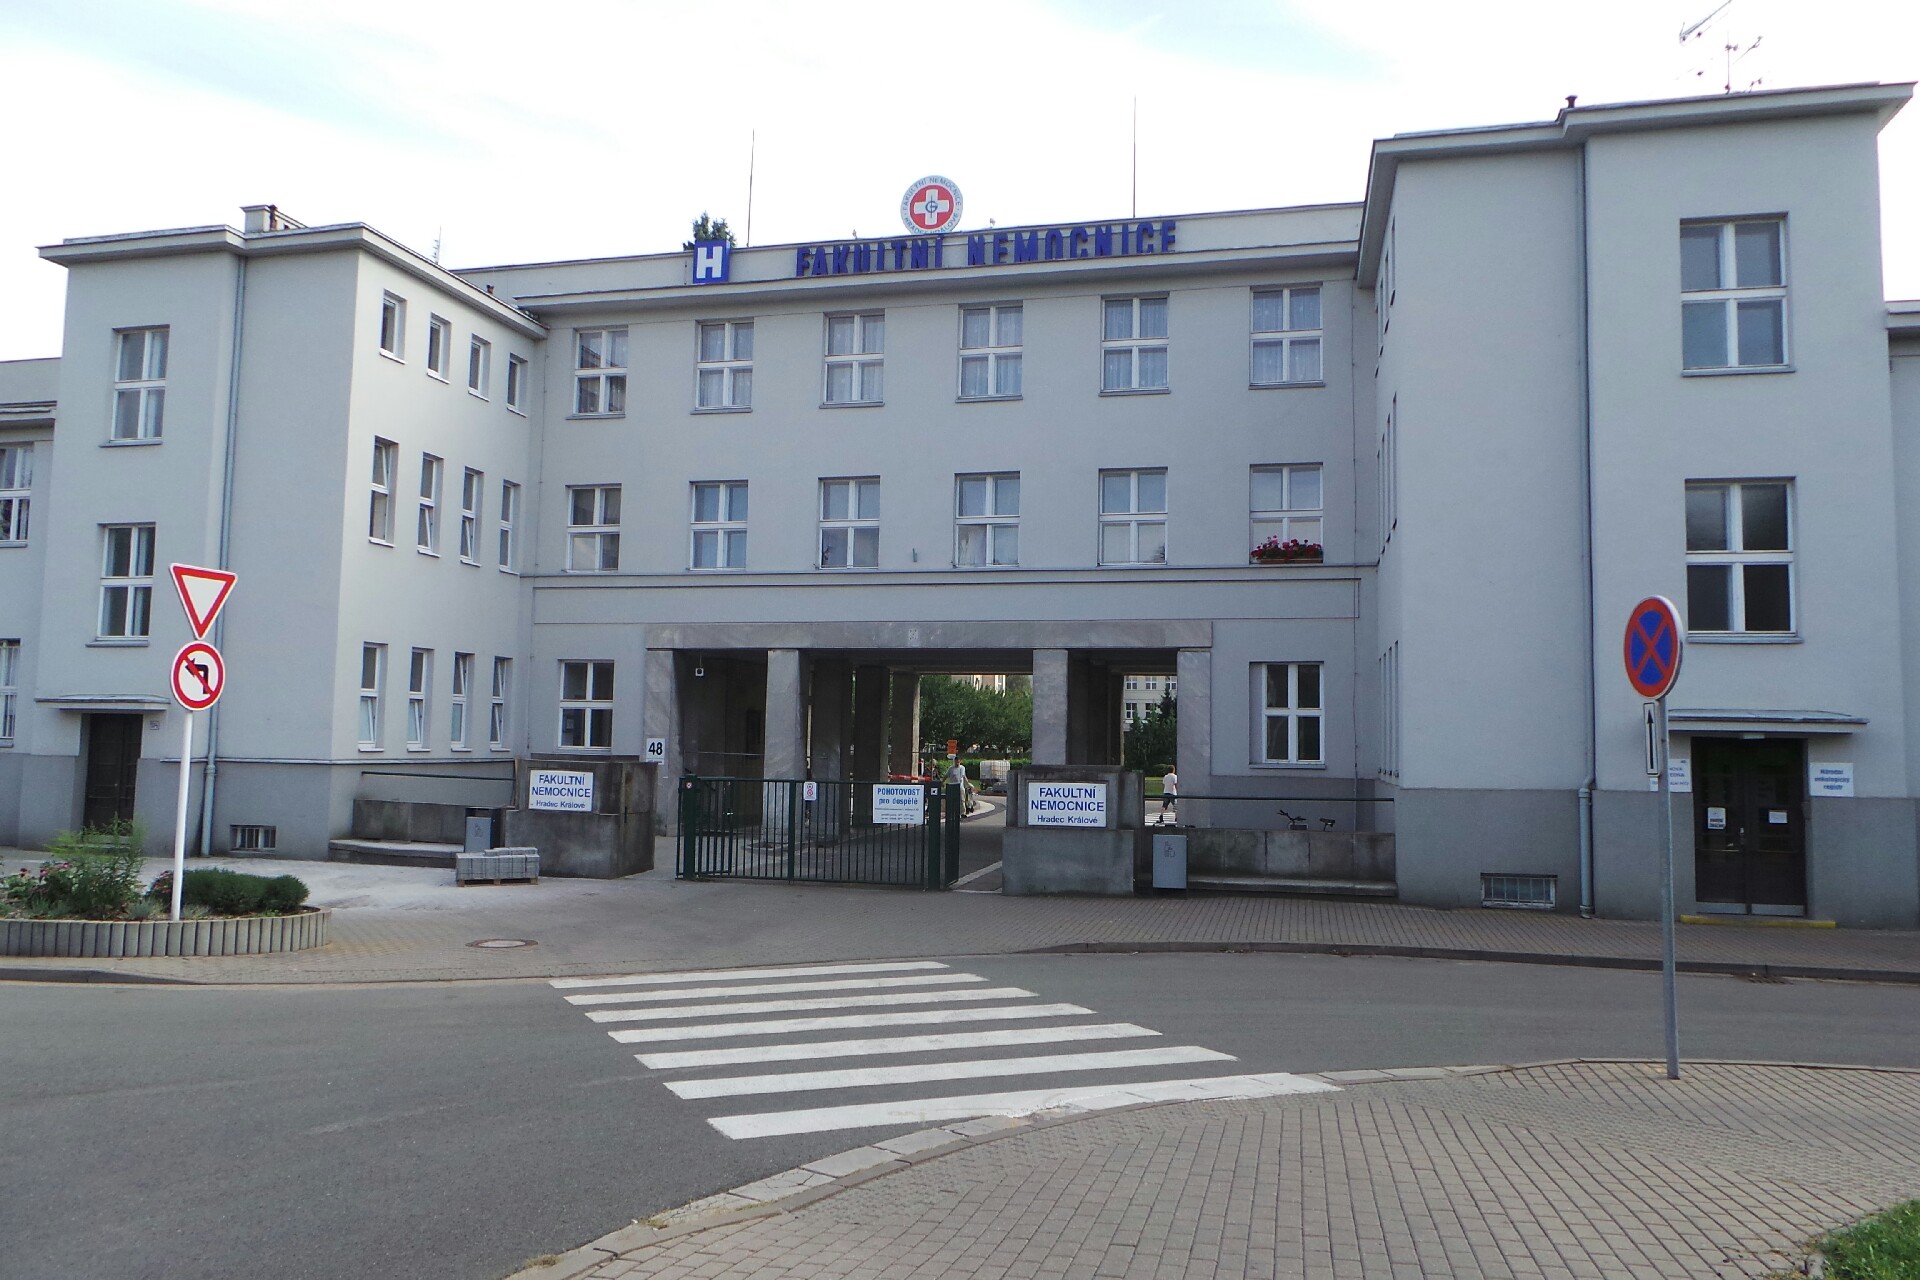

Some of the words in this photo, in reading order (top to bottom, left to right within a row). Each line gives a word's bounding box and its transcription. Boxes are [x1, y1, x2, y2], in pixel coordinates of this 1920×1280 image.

[967, 220, 1176, 266] NEMOCNICE
[696, 246, 723, 279] H
[648, 742, 663, 756] 48
[538, 773, 585, 786] FAKULTNÍ
[531, 786, 591, 798] NEMOCNICE
[877, 787, 921, 796] POHOTOVOST
[1039, 785, 1096, 799] FAKULTNÍ
[536, 799, 558, 808] Hradec
[560, 801, 586, 809] Králové
[878, 798, 890, 806] pro
[1031, 799, 1105, 812] NEMOCNICE
[1037, 815, 1065, 823] Hradec
[1067, 815, 1098, 824] Králové
